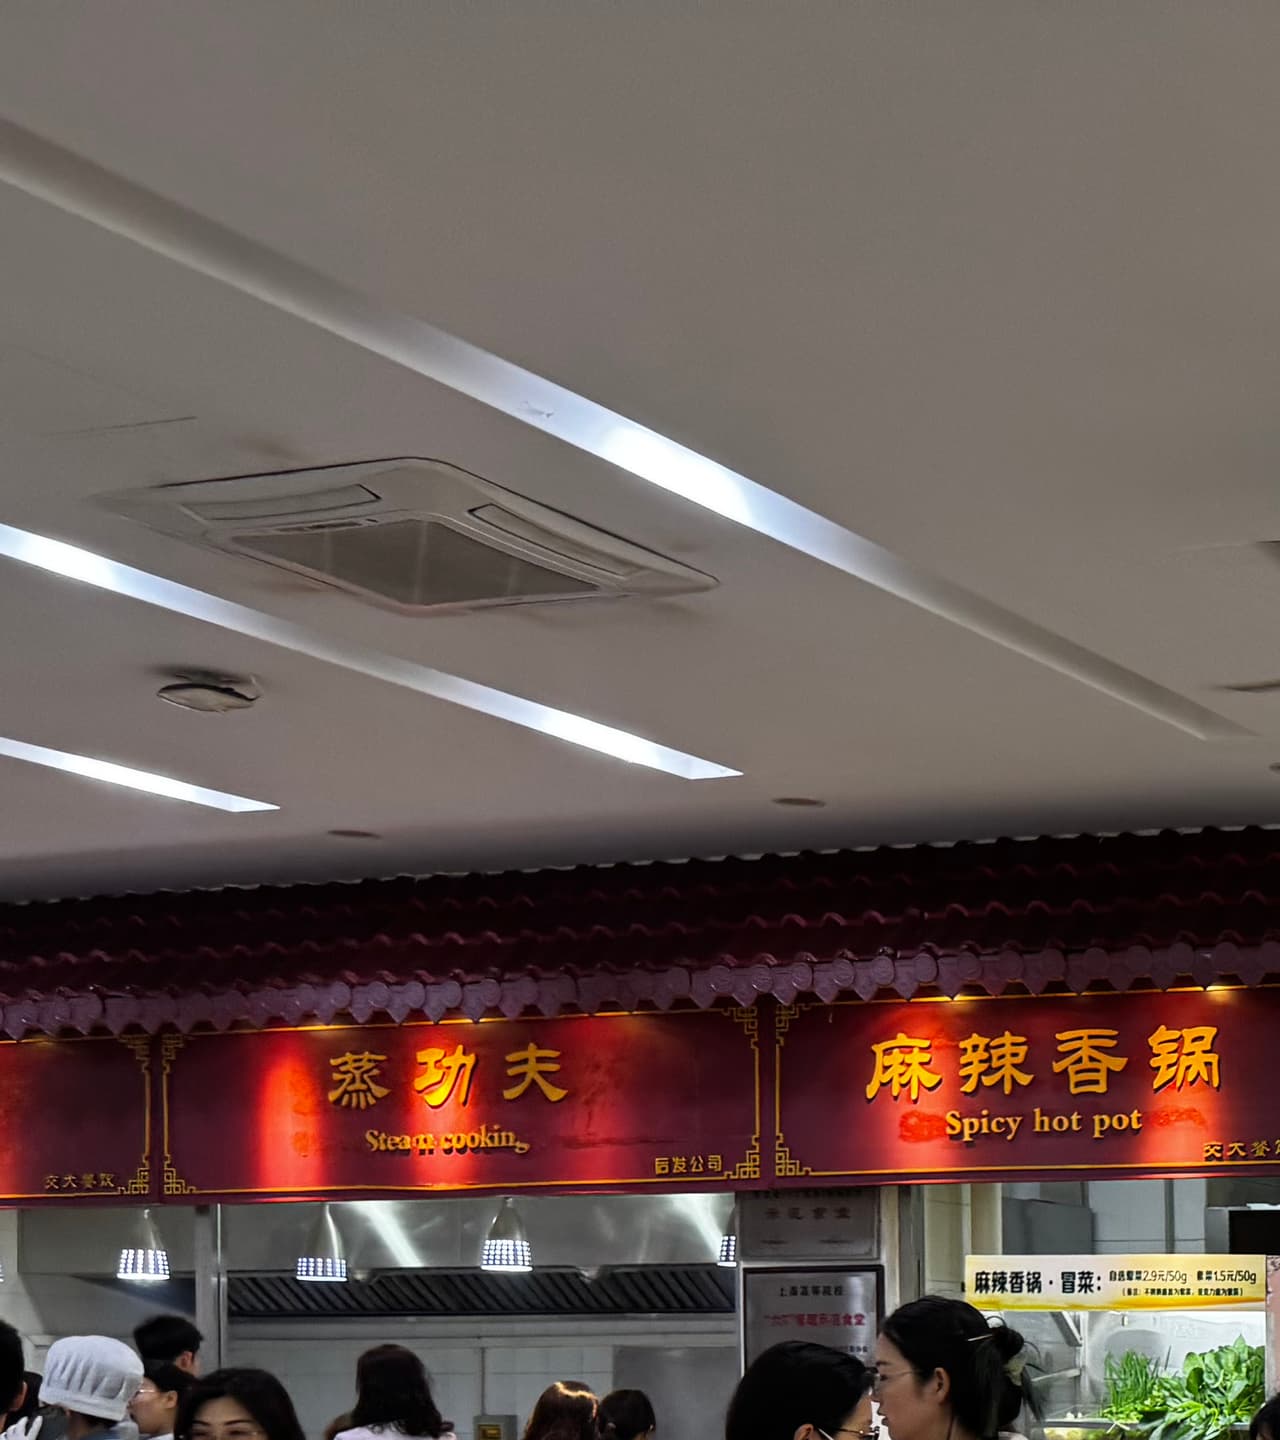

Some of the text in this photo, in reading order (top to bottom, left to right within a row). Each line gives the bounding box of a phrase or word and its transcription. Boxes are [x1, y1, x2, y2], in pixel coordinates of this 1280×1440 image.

[327, 1042, 569, 1110] 蒸功夫
[866, 1024, 1221, 1101] 麻辣香锅
[365, 1128, 435, 1152] Steam
[945, 1107, 1143, 1141] Spicy hot pot
[655, 1154, 722, 1175] 后发公司
